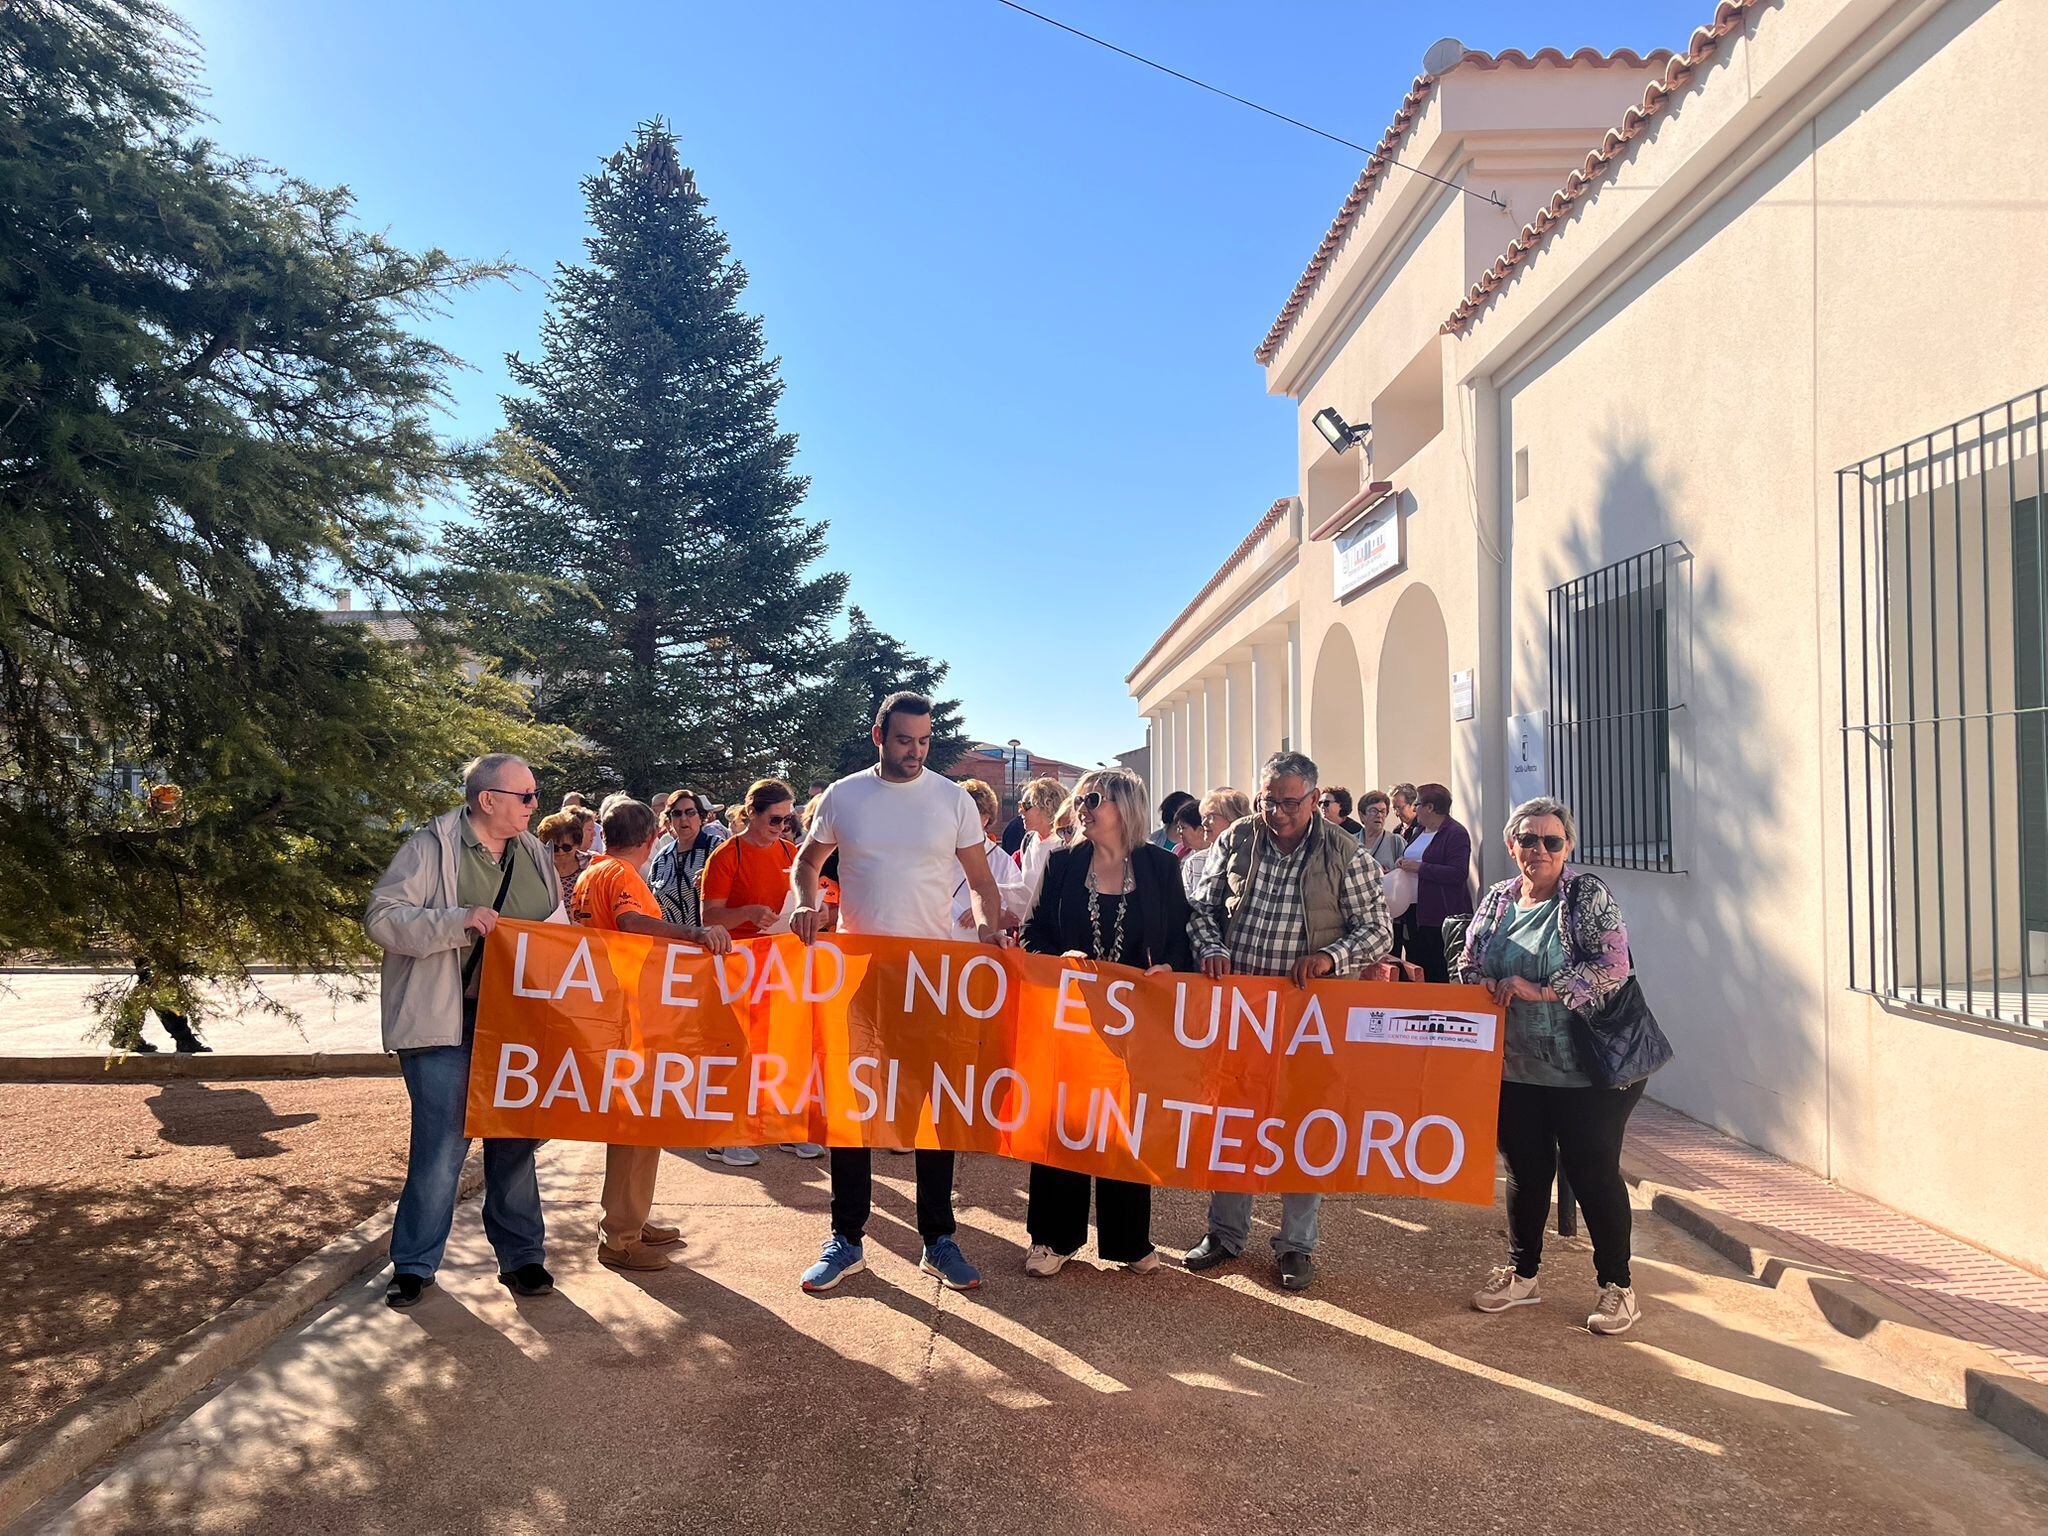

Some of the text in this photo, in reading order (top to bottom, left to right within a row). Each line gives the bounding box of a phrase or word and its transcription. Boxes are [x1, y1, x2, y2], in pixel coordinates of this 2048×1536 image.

[513, 932, 1334, 1056] LA EDAD NO ES UNA
[493, 1043, 1465, 1185] BARRERA SI NO UN TESORO
